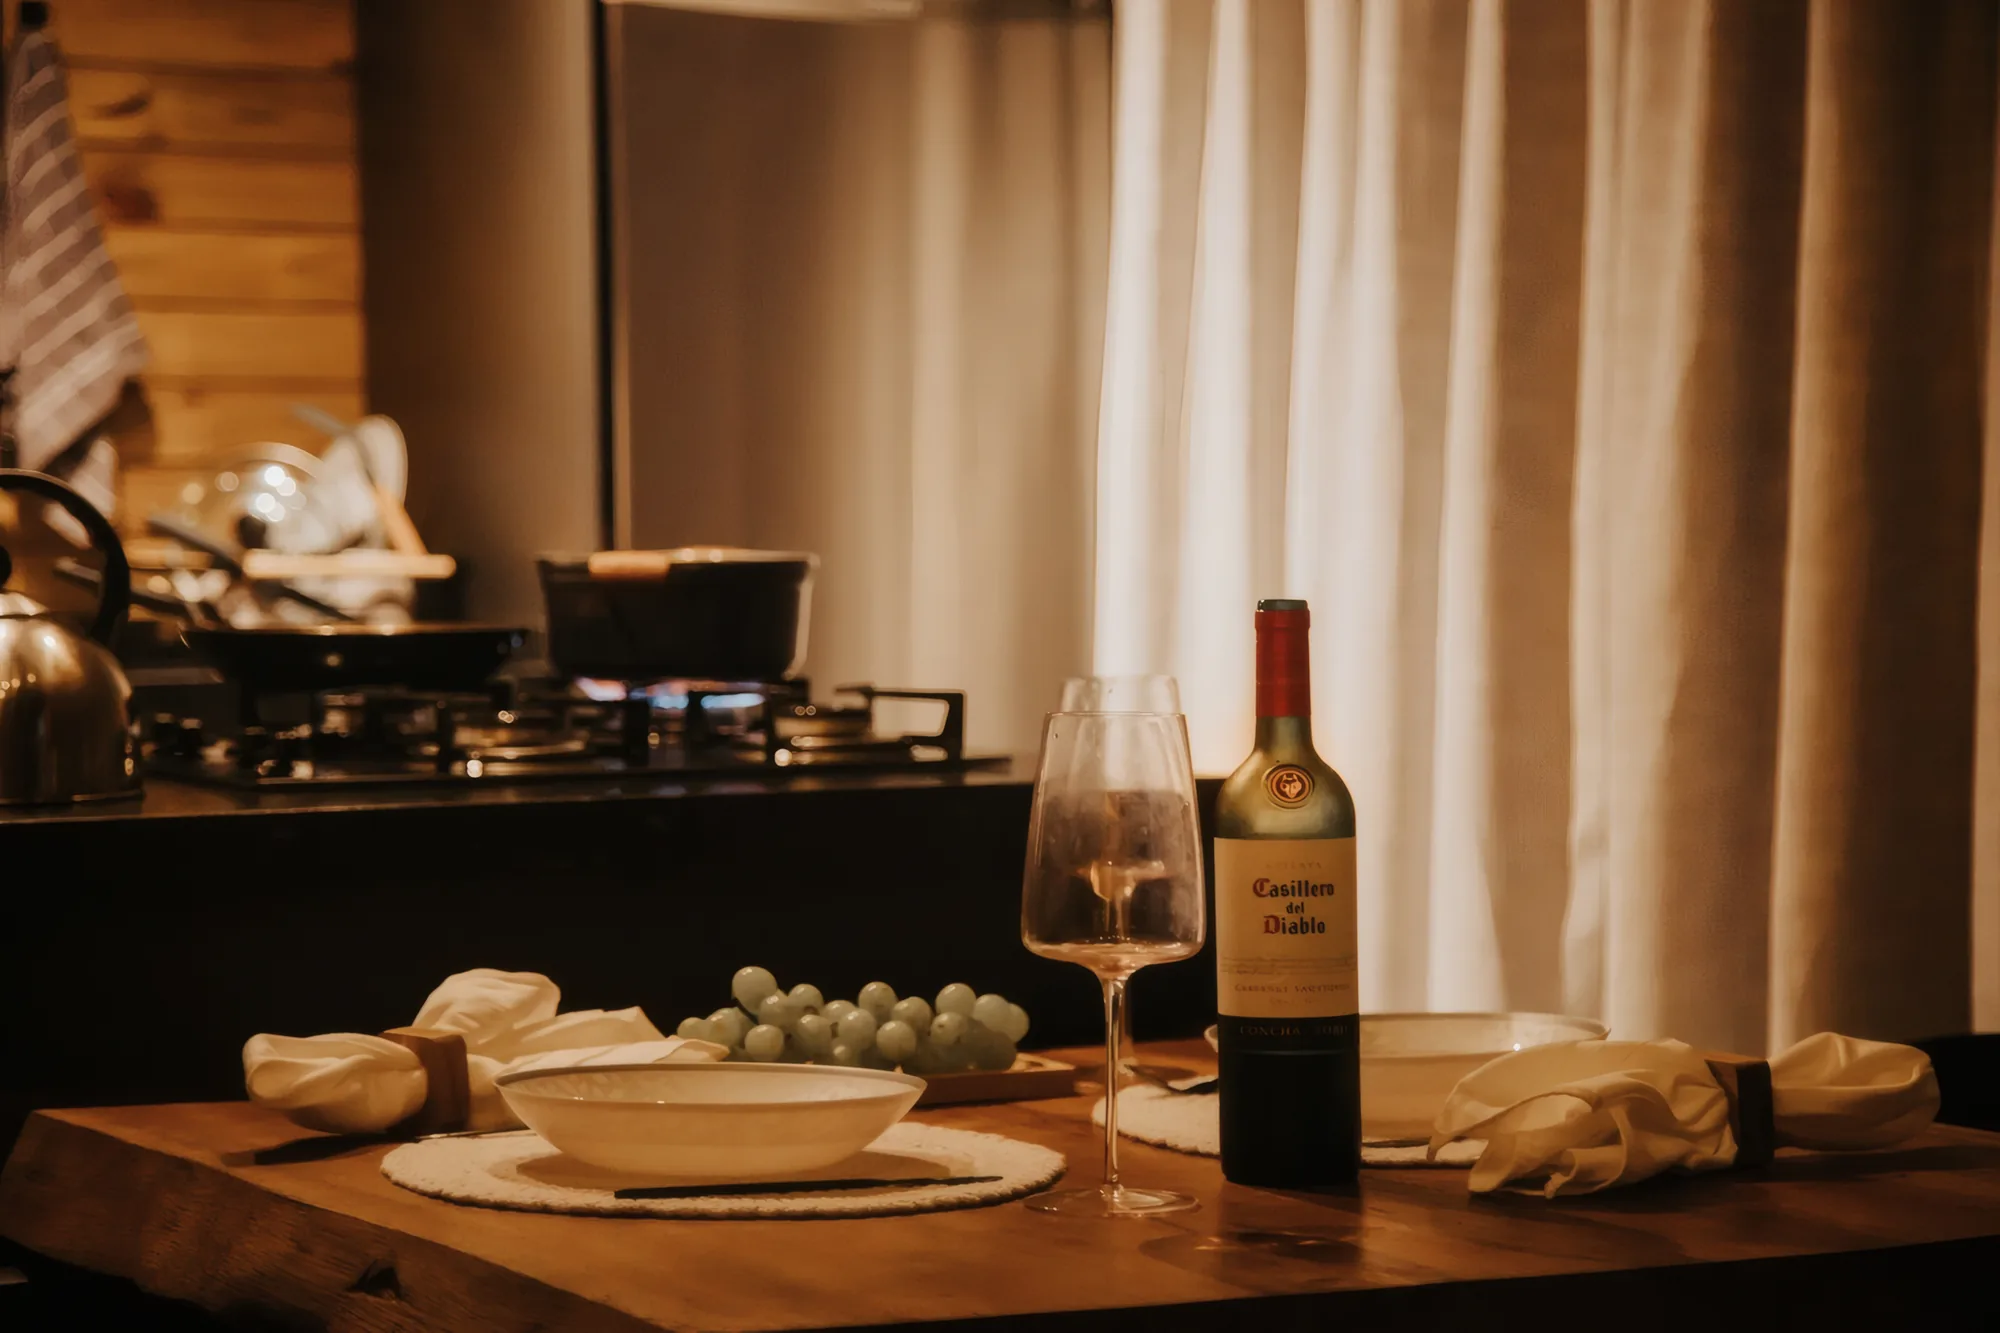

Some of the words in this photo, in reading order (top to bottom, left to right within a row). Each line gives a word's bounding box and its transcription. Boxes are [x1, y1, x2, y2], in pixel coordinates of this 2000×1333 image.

[1252, 878, 1335, 898] Casillero
[1286, 902, 1305, 915] del
[1263, 915, 1327, 935] Diablo
